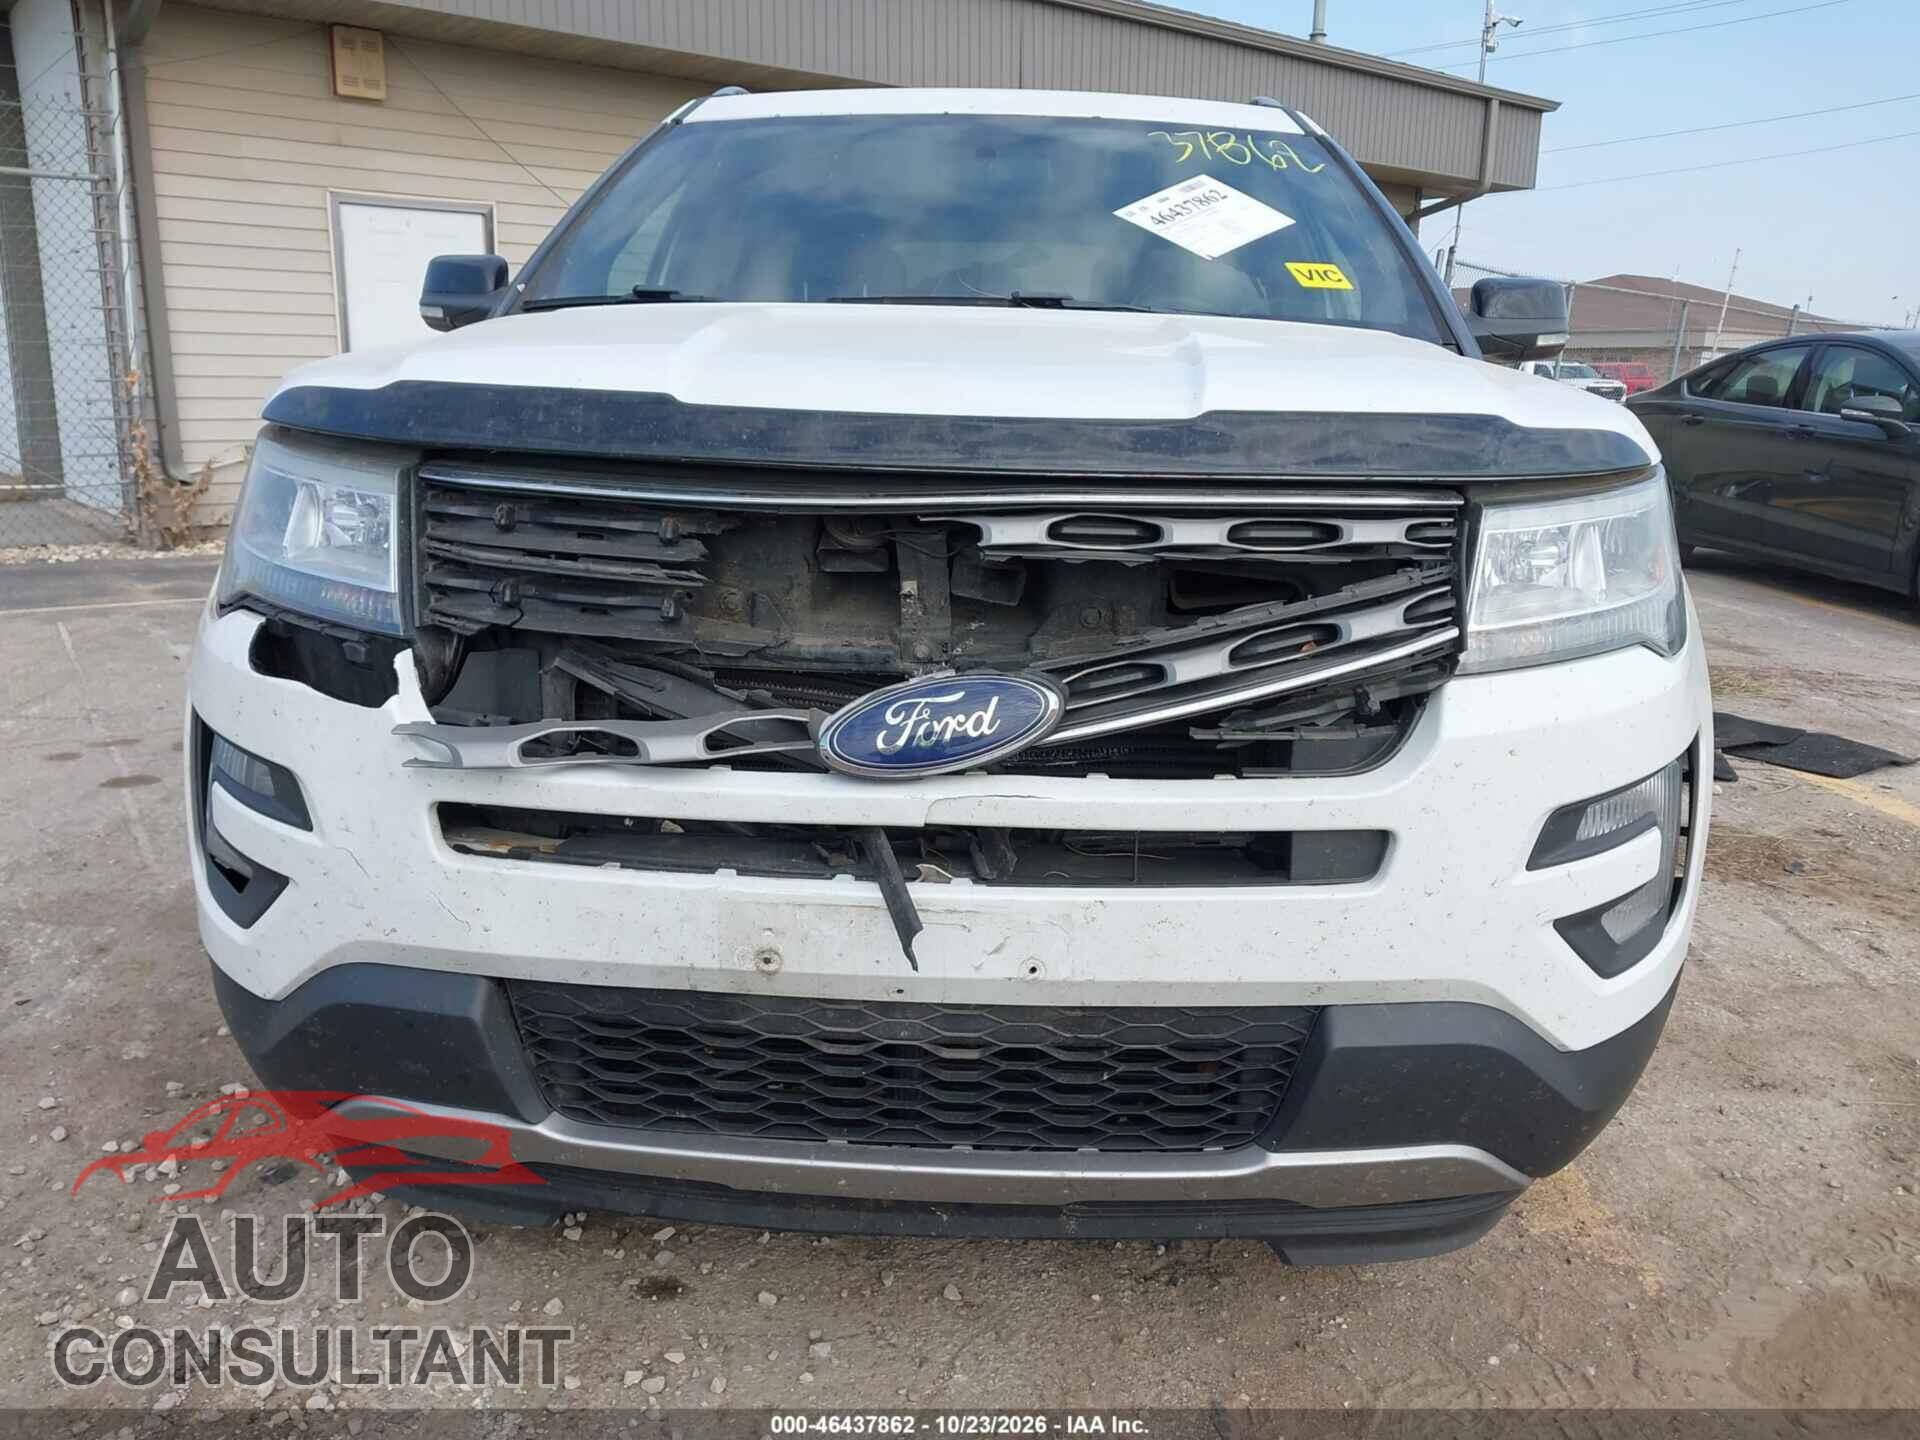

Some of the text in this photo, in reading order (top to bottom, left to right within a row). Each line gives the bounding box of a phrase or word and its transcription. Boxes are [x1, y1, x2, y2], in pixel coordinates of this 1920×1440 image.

[1149, 188, 1229, 227] 46437862
[1294, 267, 1343, 283] VIC
[876, 691, 1001, 755] Ford
